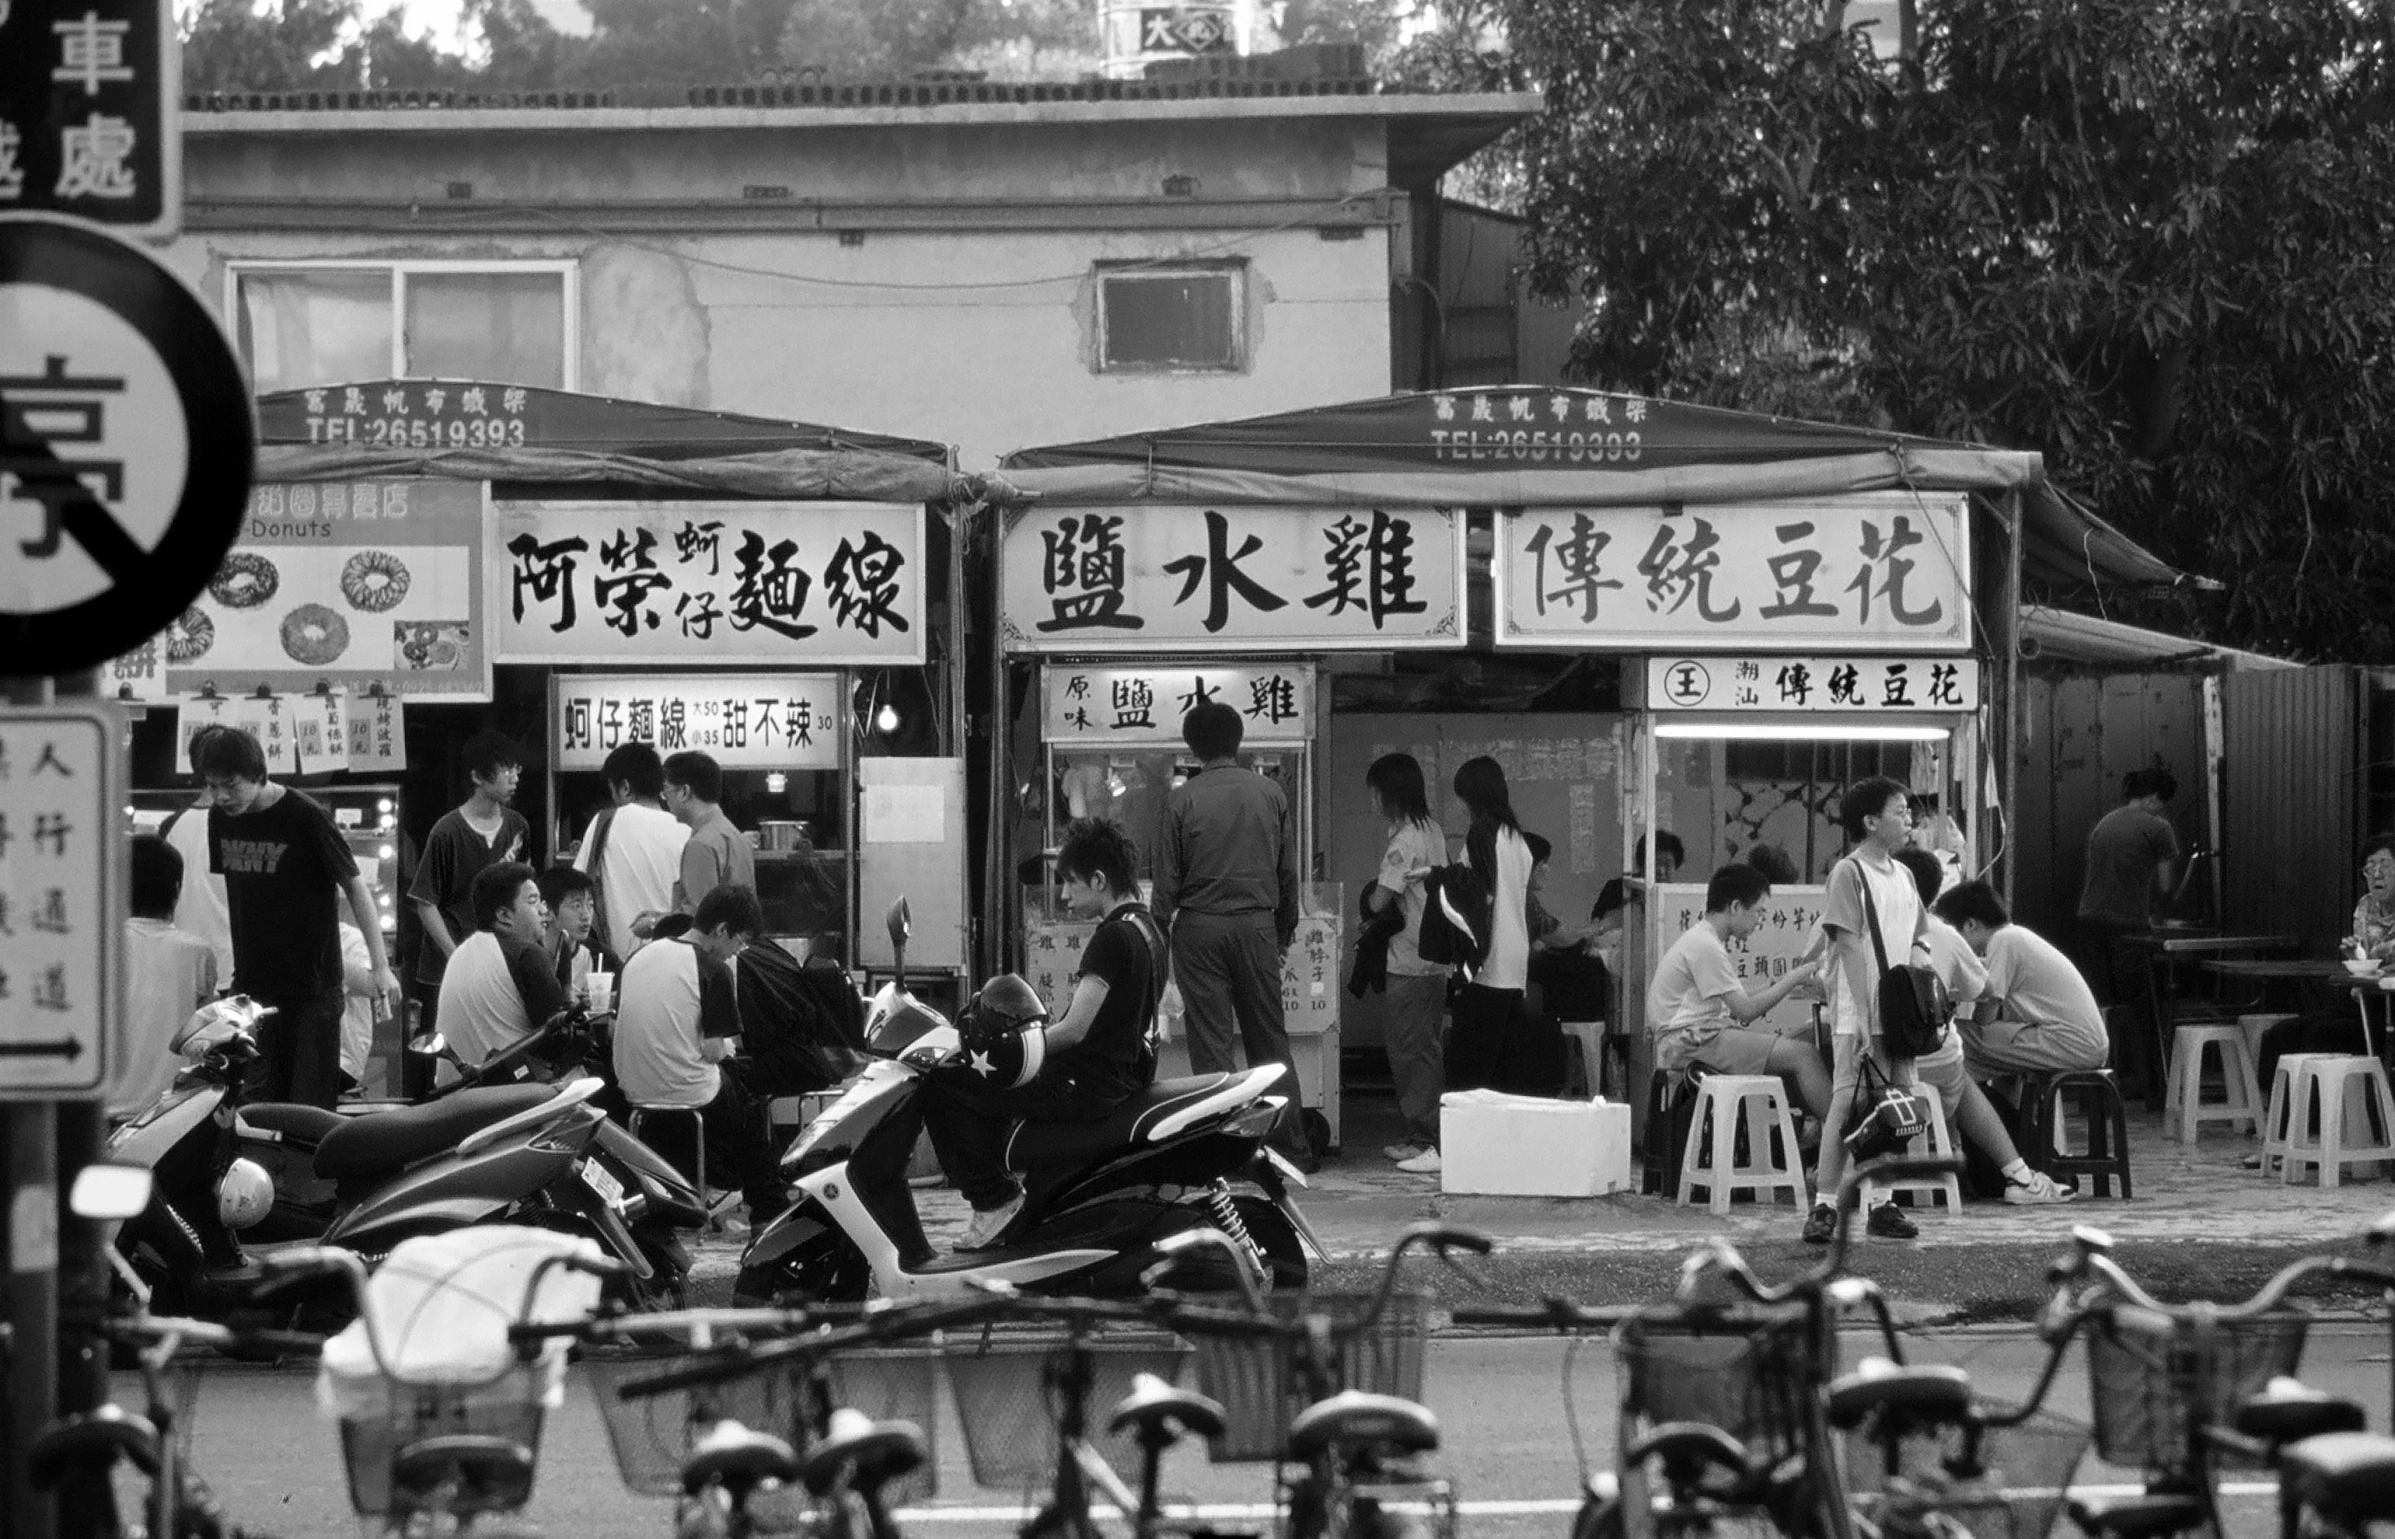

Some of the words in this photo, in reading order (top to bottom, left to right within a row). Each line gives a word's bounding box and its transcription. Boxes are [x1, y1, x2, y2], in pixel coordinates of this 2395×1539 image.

[1431, 431, 1641, 461] TEL:26519393
[1036, 509, 1428, 633] 鹽水雞
[1525, 512, 1943, 626] 傳統豆花
[1064, 674, 1094, 732] 原味
[1776, 662, 1964, 706] 傳統豆花
[565, 697, 687, 750] 蚵仔麵線
[723, 697, 813, 748] 甜不辣
[817, 715, 833, 730] 30
